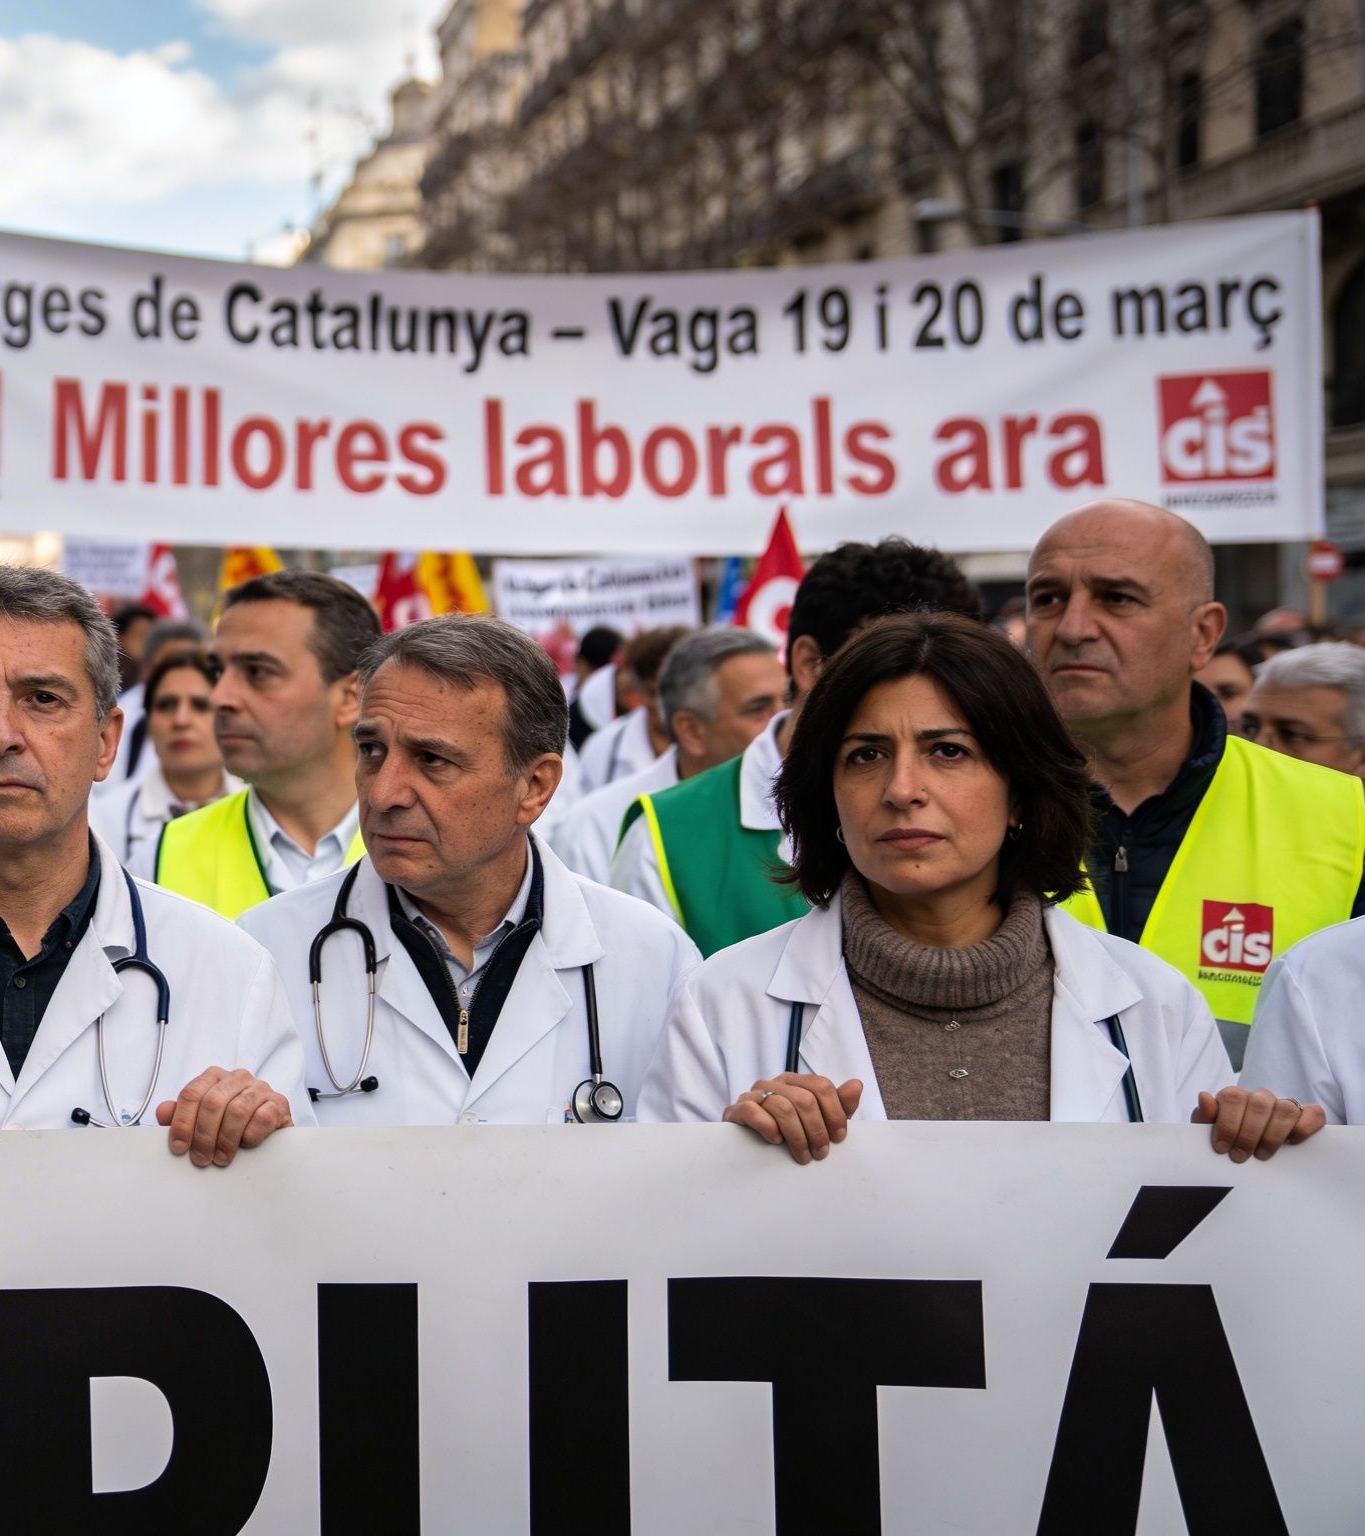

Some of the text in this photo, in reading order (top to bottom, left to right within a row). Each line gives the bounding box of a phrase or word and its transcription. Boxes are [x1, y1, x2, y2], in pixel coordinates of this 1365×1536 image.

[131, 272, 201, 343] de
[224, 281, 533, 375] Catalunya
[605, 294, 760, 375] Vaga
[782, 282, 854, 354] 19
[873, 280, 891, 352] i
[910, 277, 986, 350] 20
[1010, 273, 1086, 345] de
[1111, 274, 1285, 351] març
[52, 379, 1107, 500] Millores laborals ara
[1202, 923, 1272, 967] cis
